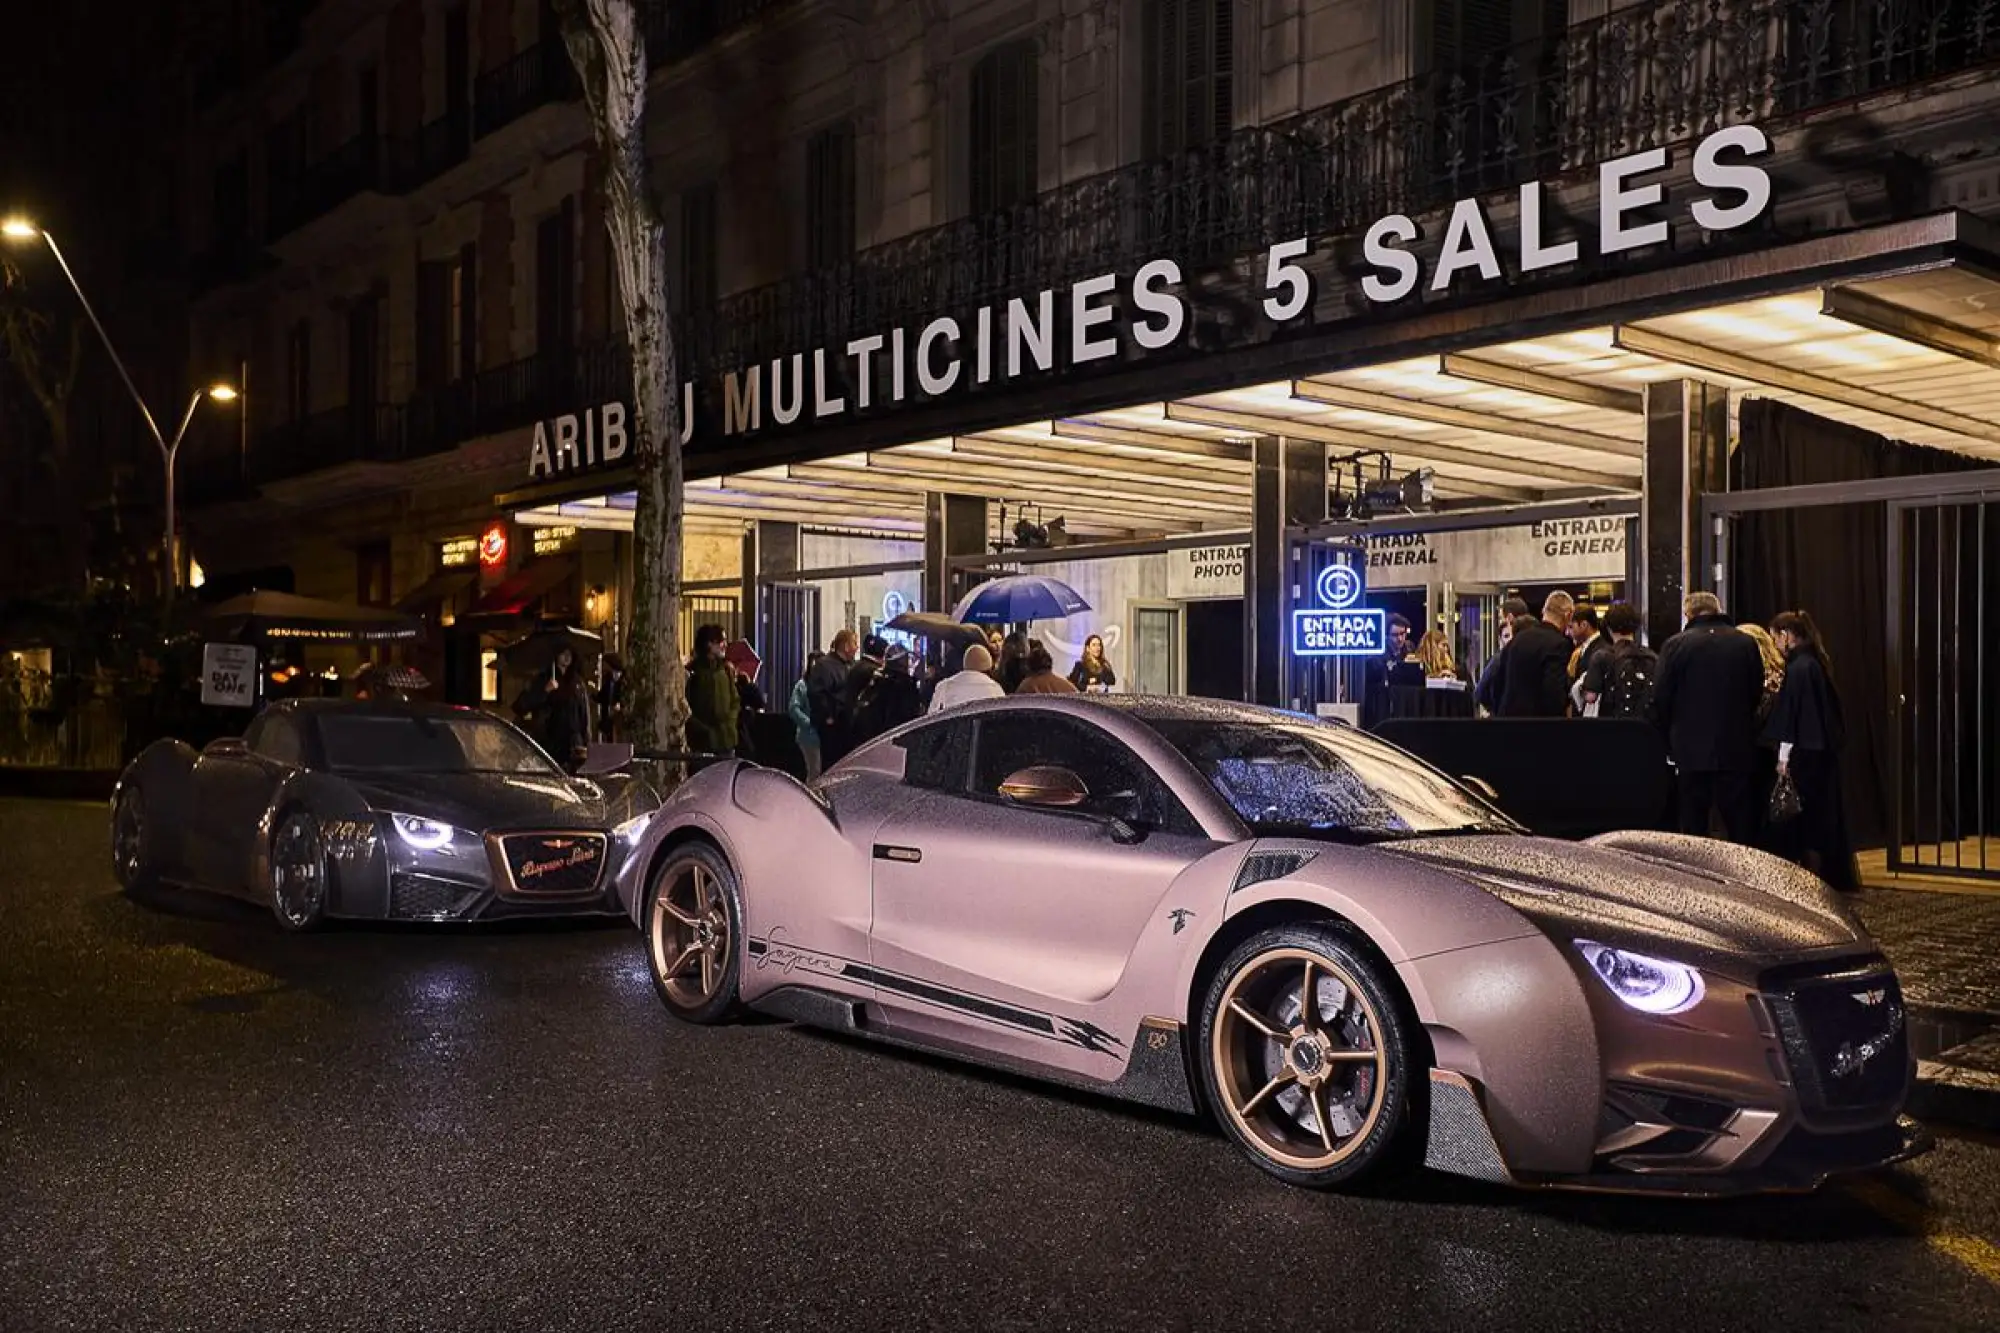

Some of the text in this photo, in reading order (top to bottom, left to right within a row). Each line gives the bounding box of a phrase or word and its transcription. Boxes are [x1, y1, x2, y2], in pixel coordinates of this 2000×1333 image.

[528, 124, 1771, 477] ARIB MULTICINES 5 SALES
[1531, 518, 1625, 538] ENTRADA
[1190, 547, 1245, 562] ENTRAD
[1545, 538, 1625, 556] GENERA
[1364, 548, 1438, 567] ENERAL
[1303, 616, 1376, 633] ENTRADA
[1304, 631, 1375, 648] GENERAL
